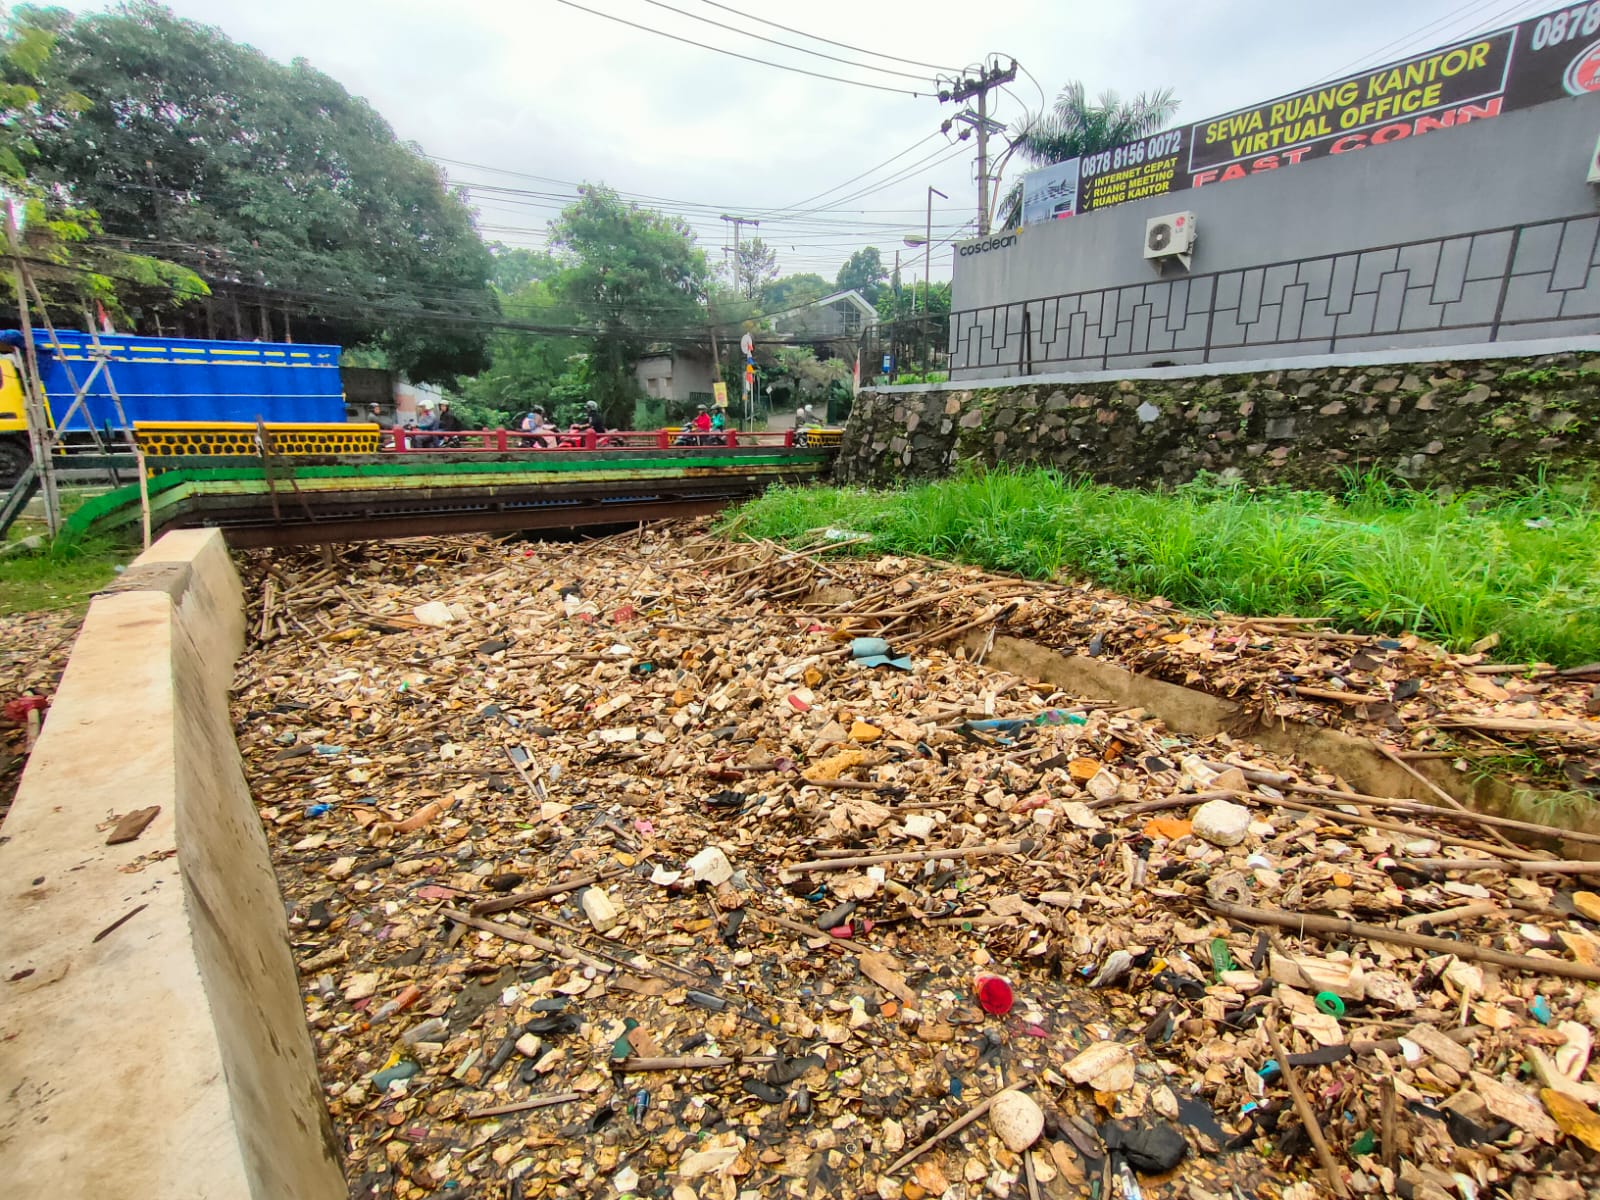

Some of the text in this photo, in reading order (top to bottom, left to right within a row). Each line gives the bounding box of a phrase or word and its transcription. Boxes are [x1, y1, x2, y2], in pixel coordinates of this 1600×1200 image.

[1531, 1, 1600, 51] 0878
[1205, 42, 1490, 144] SEWA RUANG KANTOR
[1231, 82, 1443, 157] VIRTUAL OFFICE
[1081, 130, 1182, 178] 0878 8156 0072
[1094, 157, 1178, 187] INTERNET CEPAT
[1192, 146, 1312, 188] FAST
[1092, 192, 1126, 208] RUANG
[1127, 181, 1169, 199] KANTOR
[1093, 169, 1174, 198] RUANG MEETING
[960, 235, 1017, 256] cosclean
